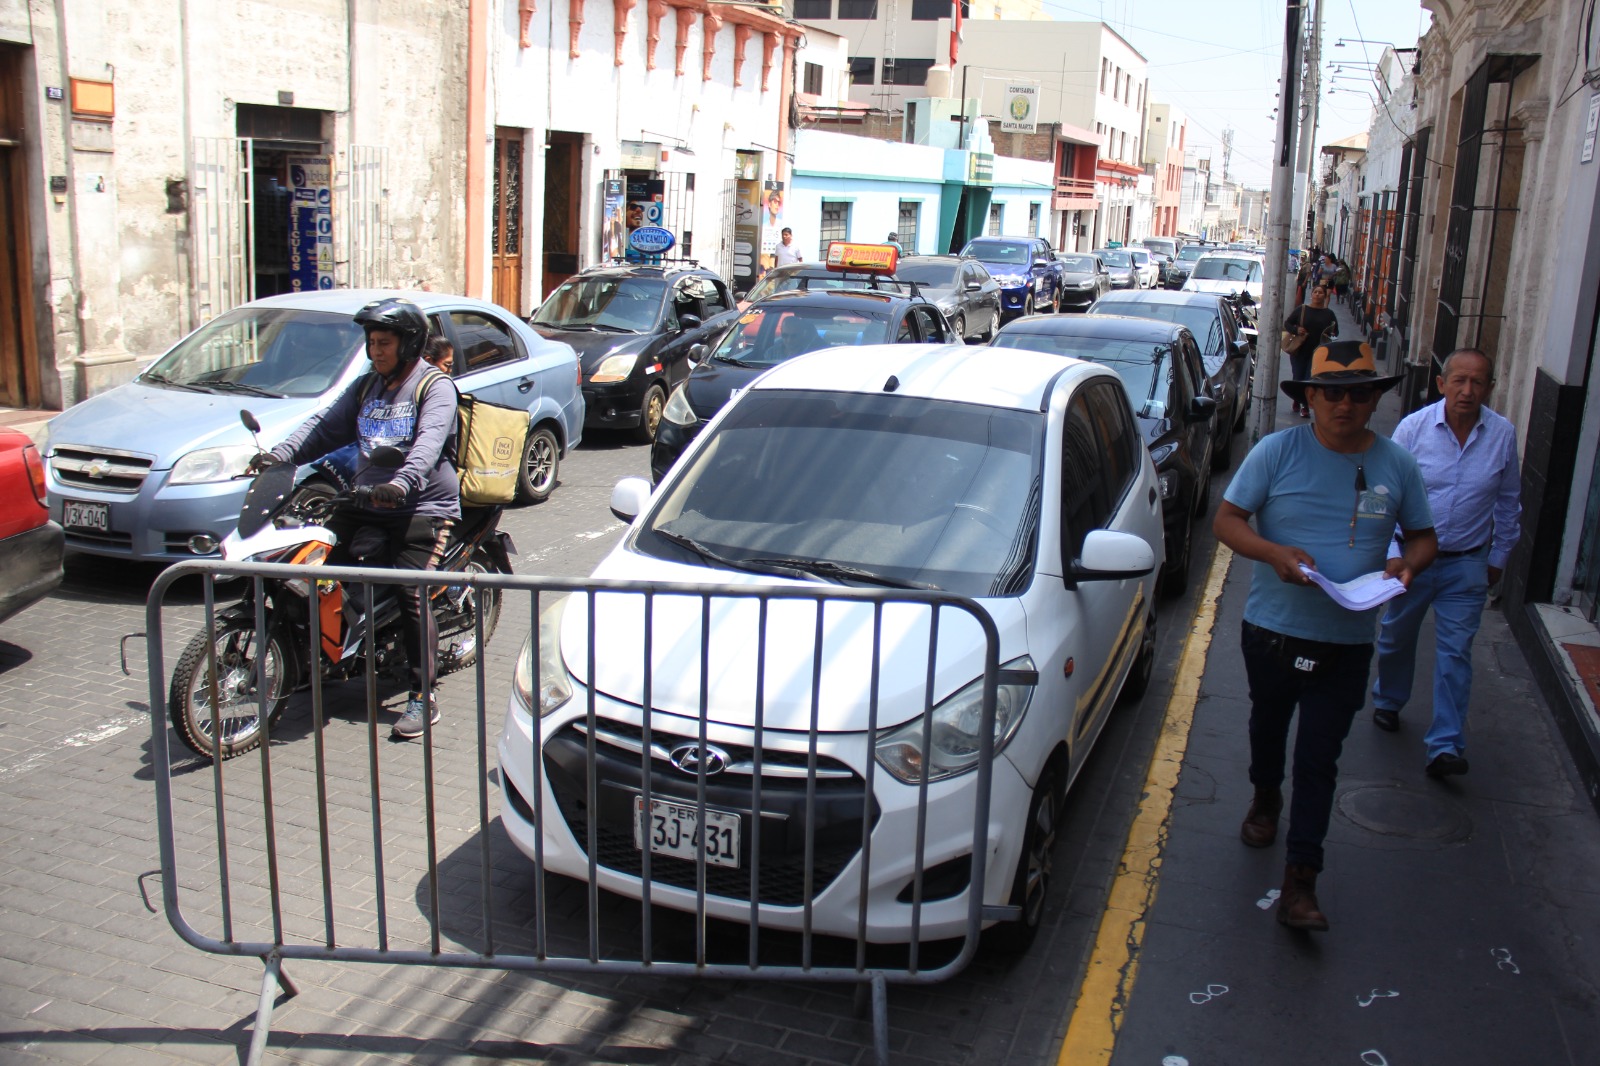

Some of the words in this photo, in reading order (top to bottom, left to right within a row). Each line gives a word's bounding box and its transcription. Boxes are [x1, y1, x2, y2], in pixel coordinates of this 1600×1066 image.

[632, 234, 645, 243] SAN
[645, 233, 668, 244] CAMILO
[66, 507, 107, 528] V3K-040
[1294, 656, 1316, 671] CAT
[668, 806, 699, 821] PER
[641, 813, 734, 859] 3J-31
